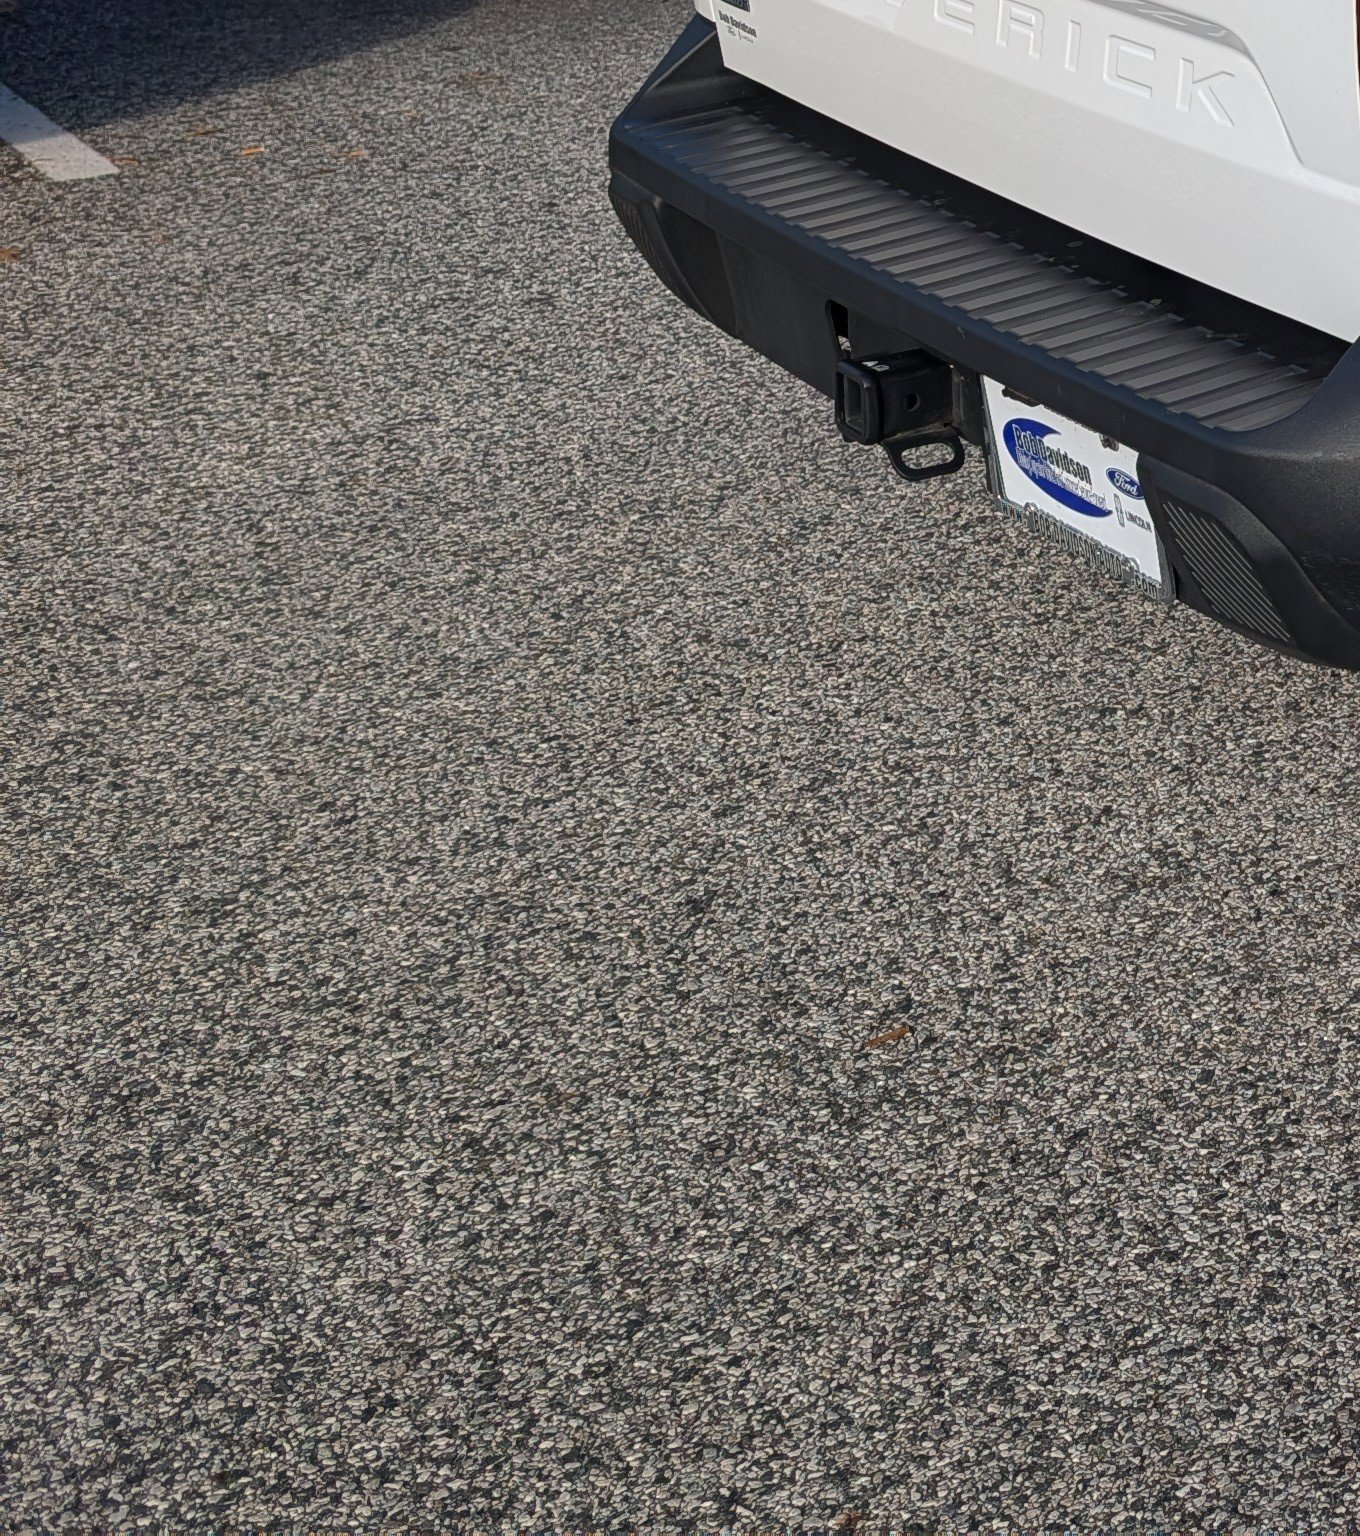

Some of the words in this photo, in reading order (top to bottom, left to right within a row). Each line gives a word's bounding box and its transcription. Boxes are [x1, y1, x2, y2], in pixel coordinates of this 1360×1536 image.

[1012, 424, 1040, 459] Bob
[1038, 437, 1093, 487] Davidson
[1113, 473, 1138, 496] Ford
[1125, 510, 1152, 533] LINCOLN
